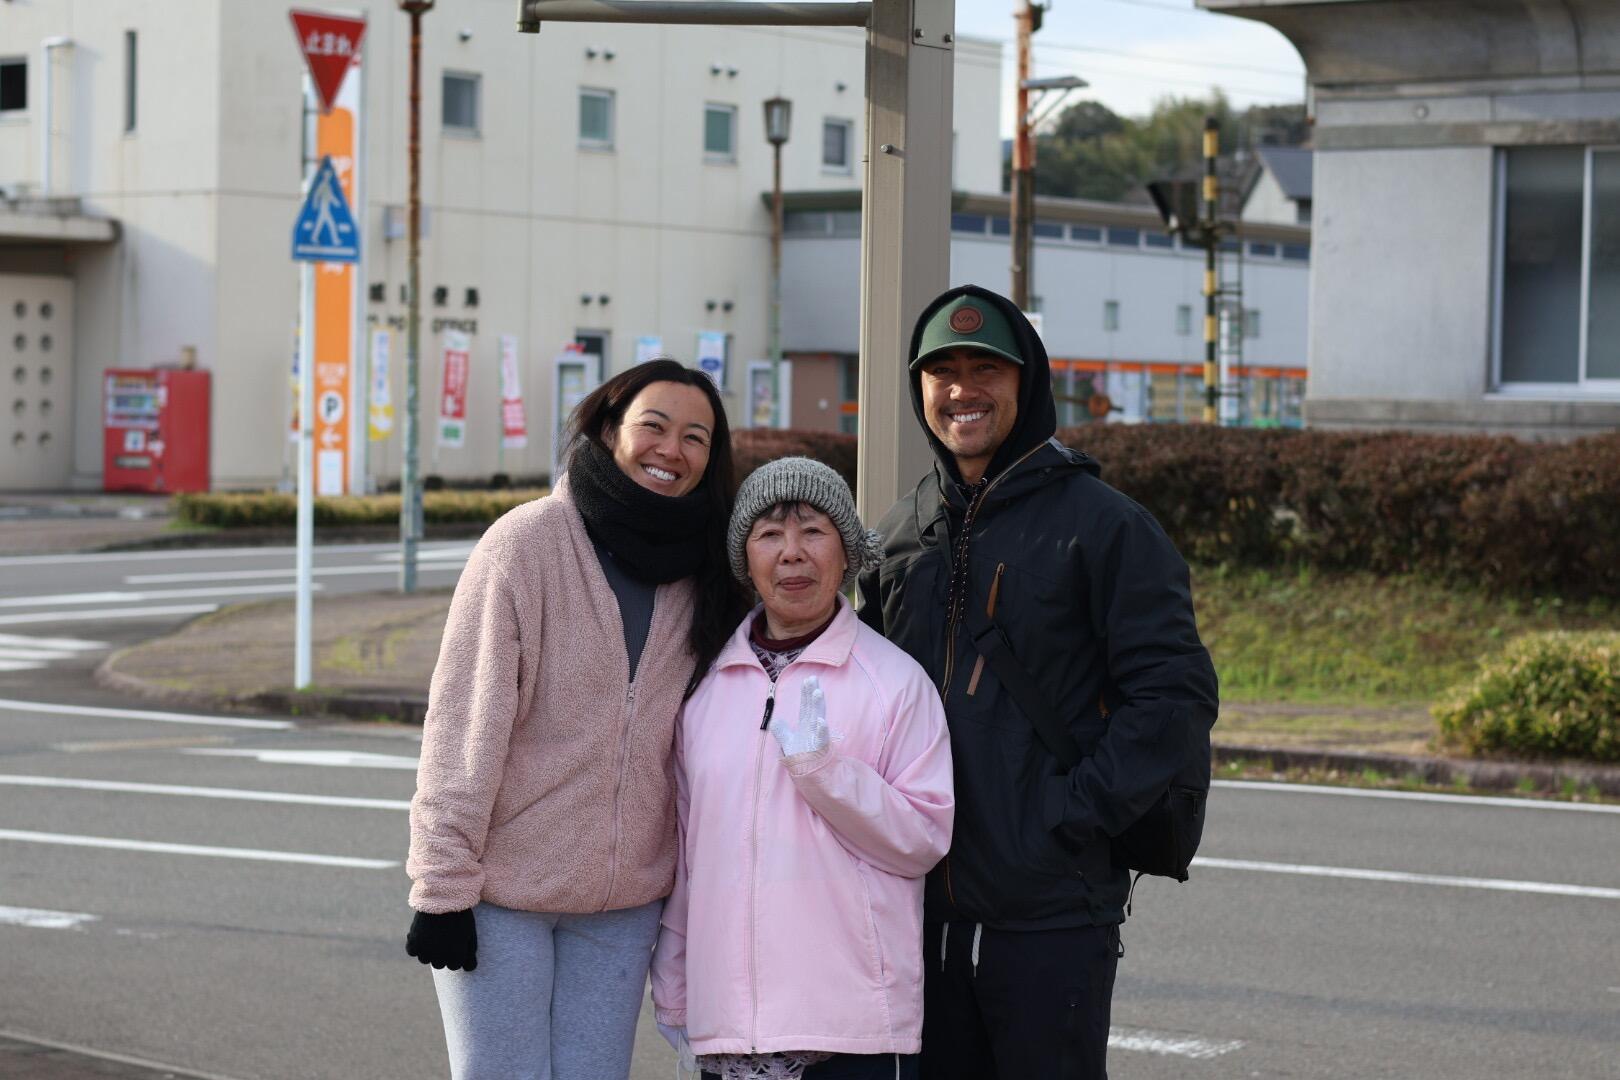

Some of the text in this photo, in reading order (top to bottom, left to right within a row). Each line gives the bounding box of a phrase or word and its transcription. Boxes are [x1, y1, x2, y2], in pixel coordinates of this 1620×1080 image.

[306, 30, 352, 56] 止まれ
[326, 395, 340, 418] P
